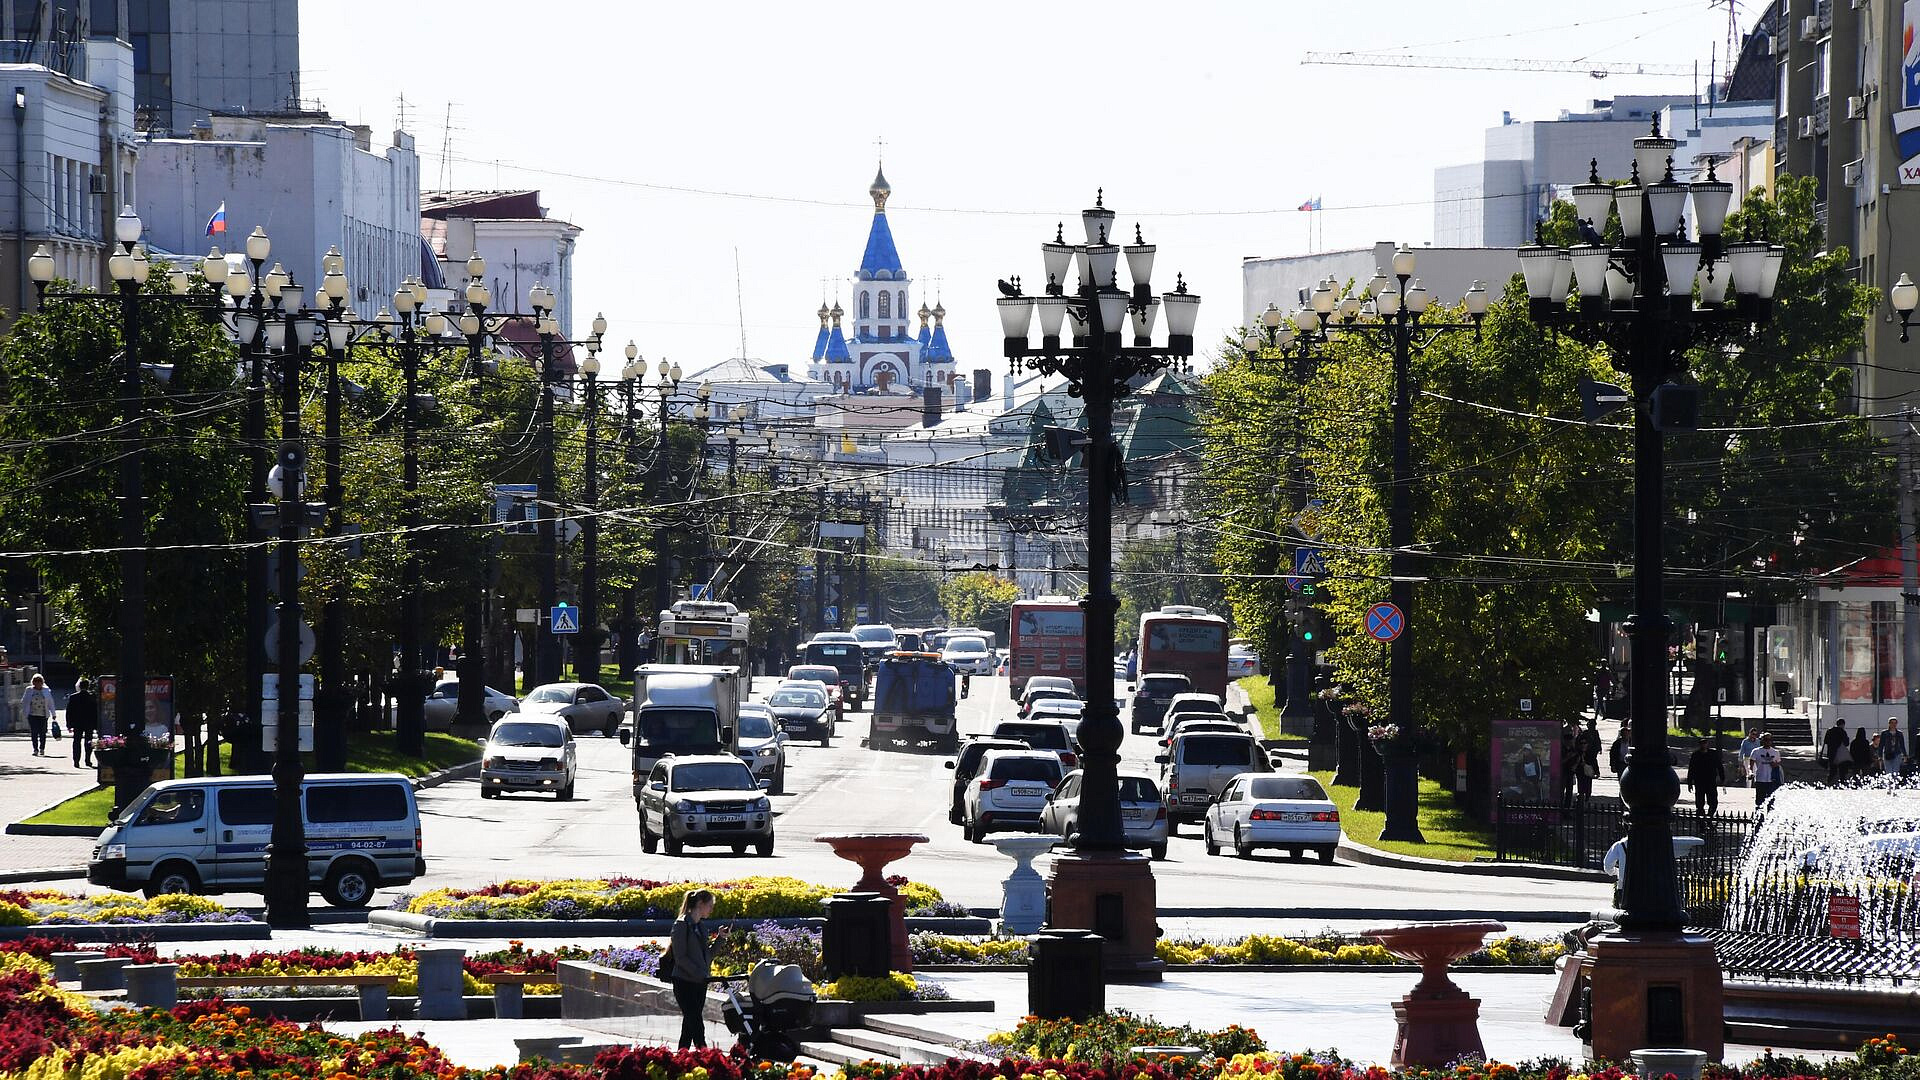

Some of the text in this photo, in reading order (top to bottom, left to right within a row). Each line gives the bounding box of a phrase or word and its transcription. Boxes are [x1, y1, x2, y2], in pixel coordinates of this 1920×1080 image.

[1303, 584, 1315, 595] 26
[351, 841, 387, 849] 94-02-87
[1830, 905, 1858, 913] ЗАПРЕЩЕНО
